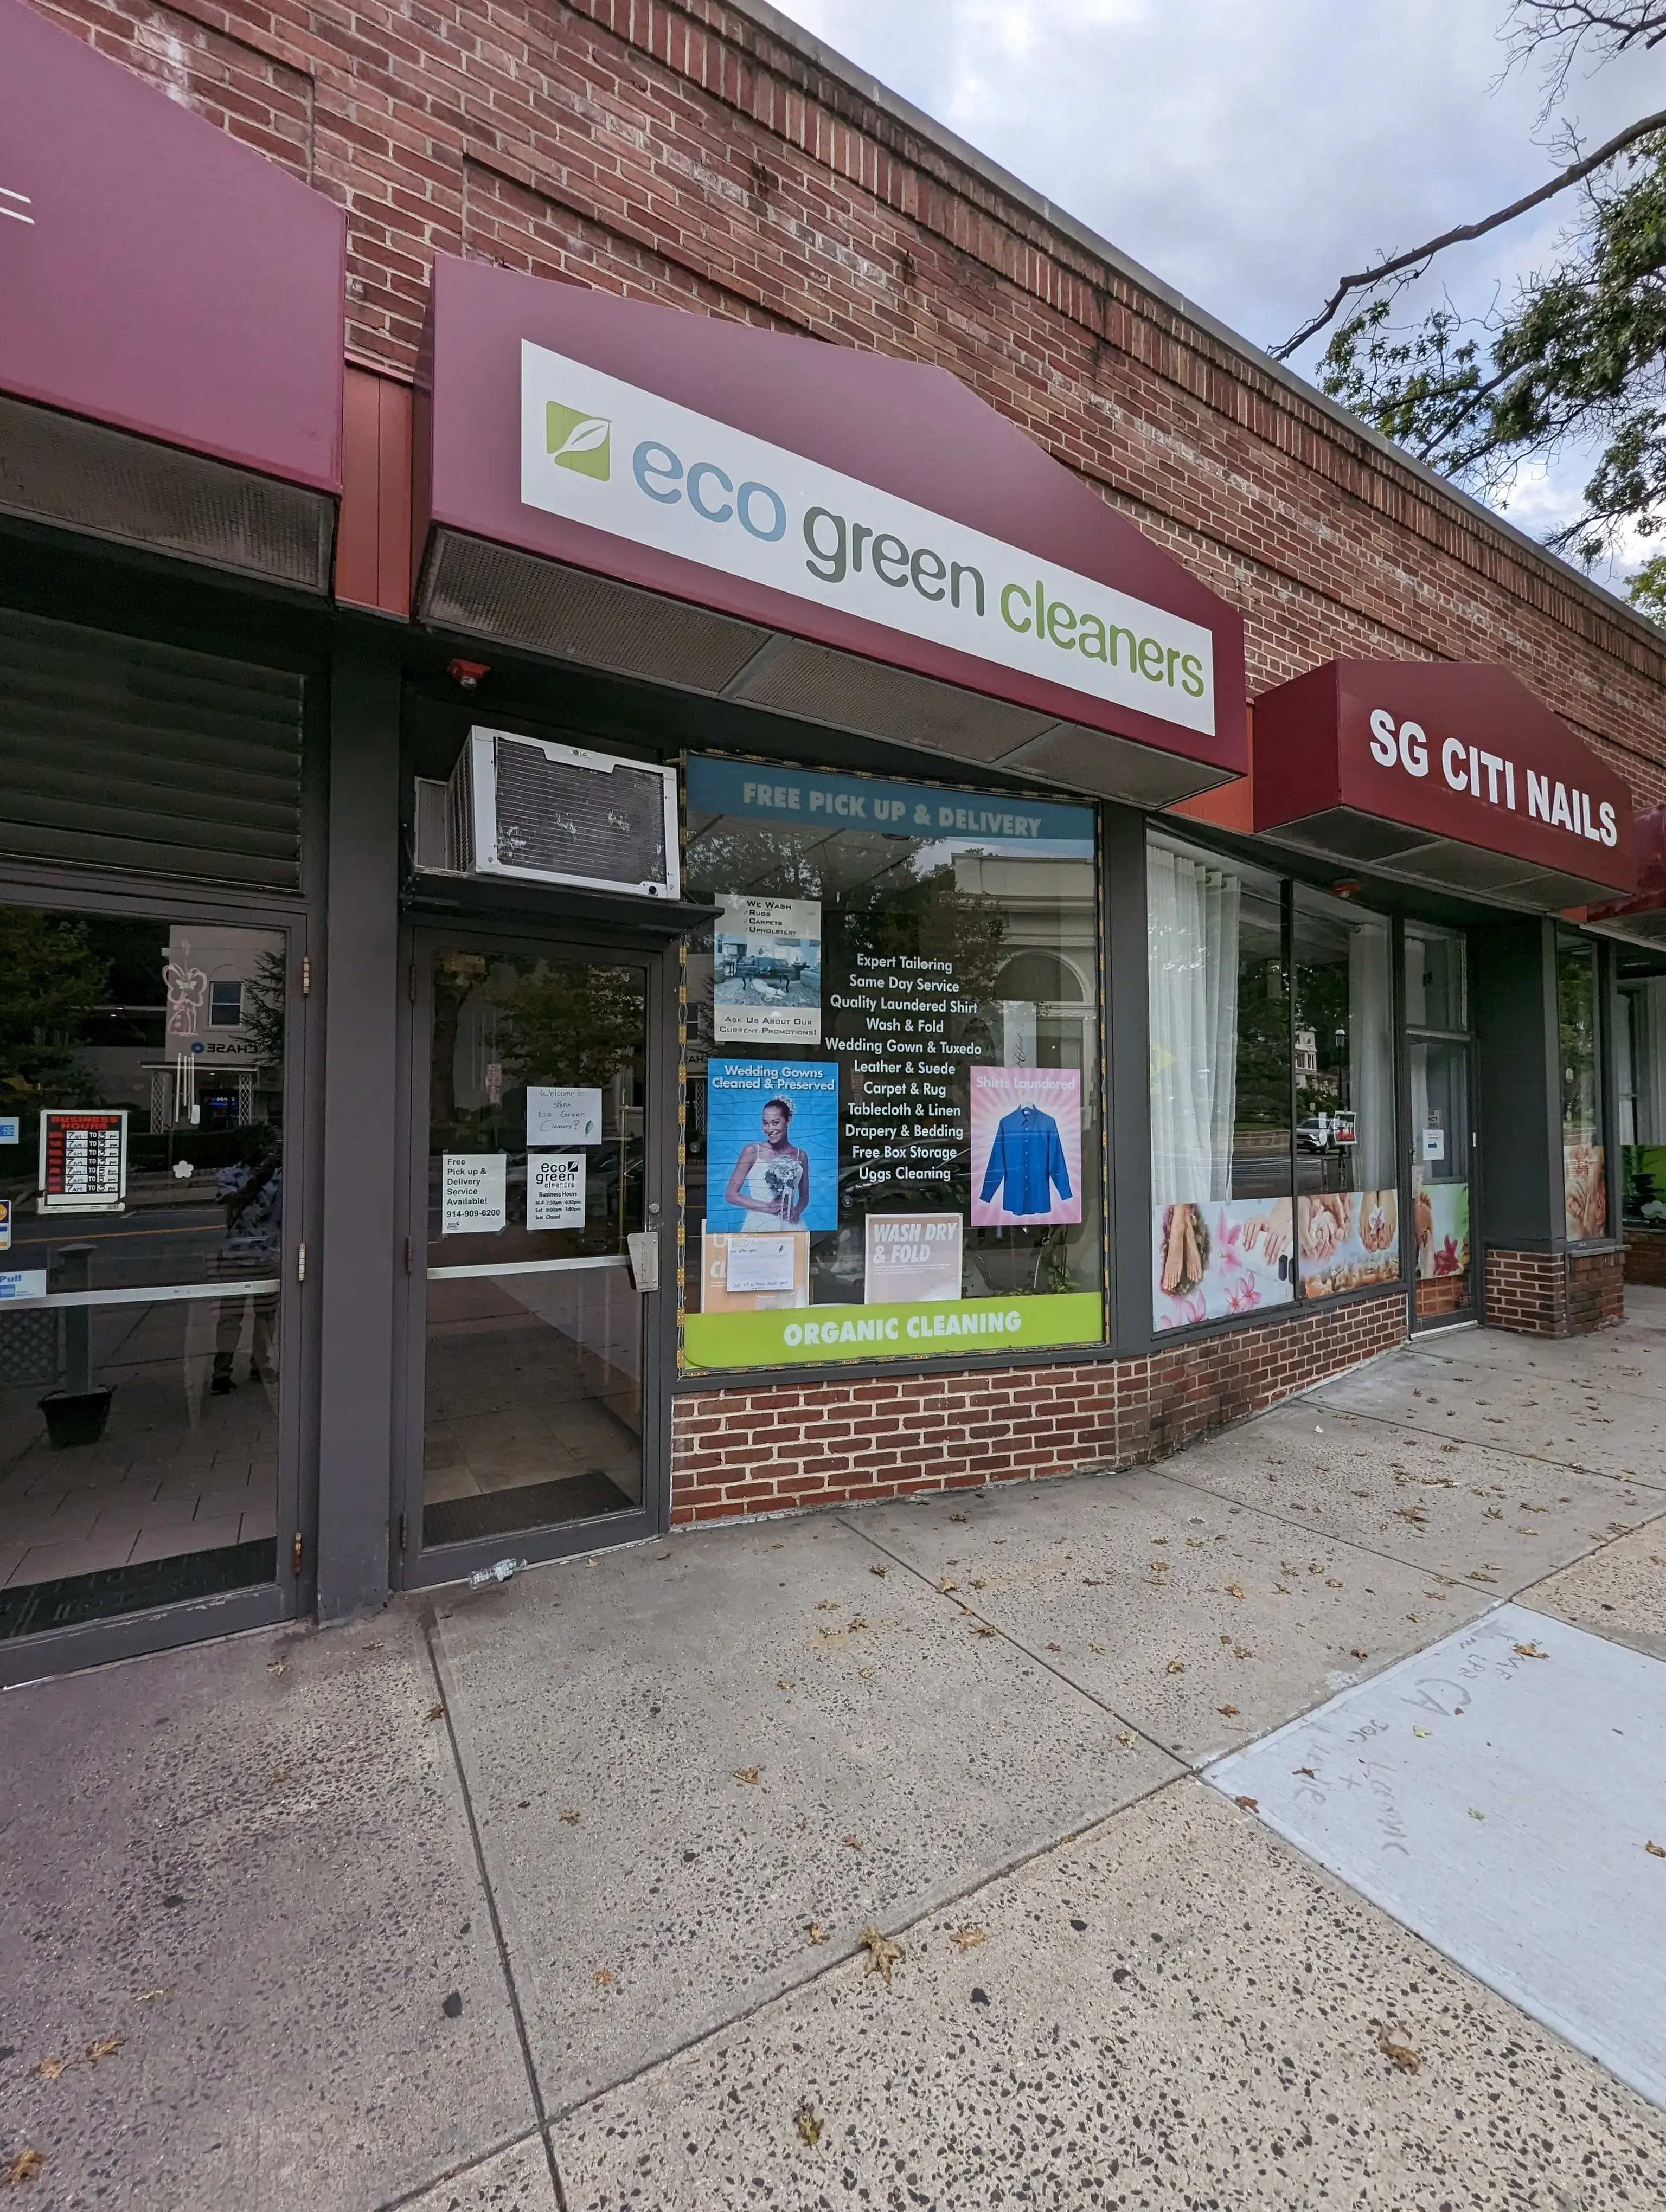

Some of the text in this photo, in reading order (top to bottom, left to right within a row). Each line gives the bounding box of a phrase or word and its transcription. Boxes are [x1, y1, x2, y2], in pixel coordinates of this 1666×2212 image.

[632, 440, 1204, 697] eco green cleaners
[1370, 709, 1617, 847] SG CITI NAILS
[743, 782, 1042, 837] FREE PICK UP & DELIVERY
[857, 954, 952, 974] Expert Tailoring
[849, 974, 959, 993] Same Day Service
[830, 995, 977, 1014] Quality Laundered Shirt
[866, 1017, 944, 1033] Wash & Fold
[825, 1038, 981, 1055] Wedding Gown & Tuxedo
[725, 1066, 823, 1078] Wedding Gowns
[854, 1060, 955, 1075] Leather & Suede
[712, 1077, 834, 1090] Cleaned & Preserved
[864, 1082, 946, 1098] Carpet & Rug
[976, 1077, 1075, 1090] Shirts Laundered
[848, 1103, 960, 1116] Tablecloth & Linen
[845, 1124, 963, 1139] Drapery & Bedding
[853, 1146, 957, 1160] Free Box Storage
[541, 1163, 566, 1172] eco
[859, 1167, 950, 1182] Uggs Cleaning
[536, 1173, 574, 1184] green
[874, 1223, 957, 1242] WASH DRY
[873, 1245, 930, 1263] & FOLD
[784, 1311, 1021, 1346] ORGANIC CLEANING
